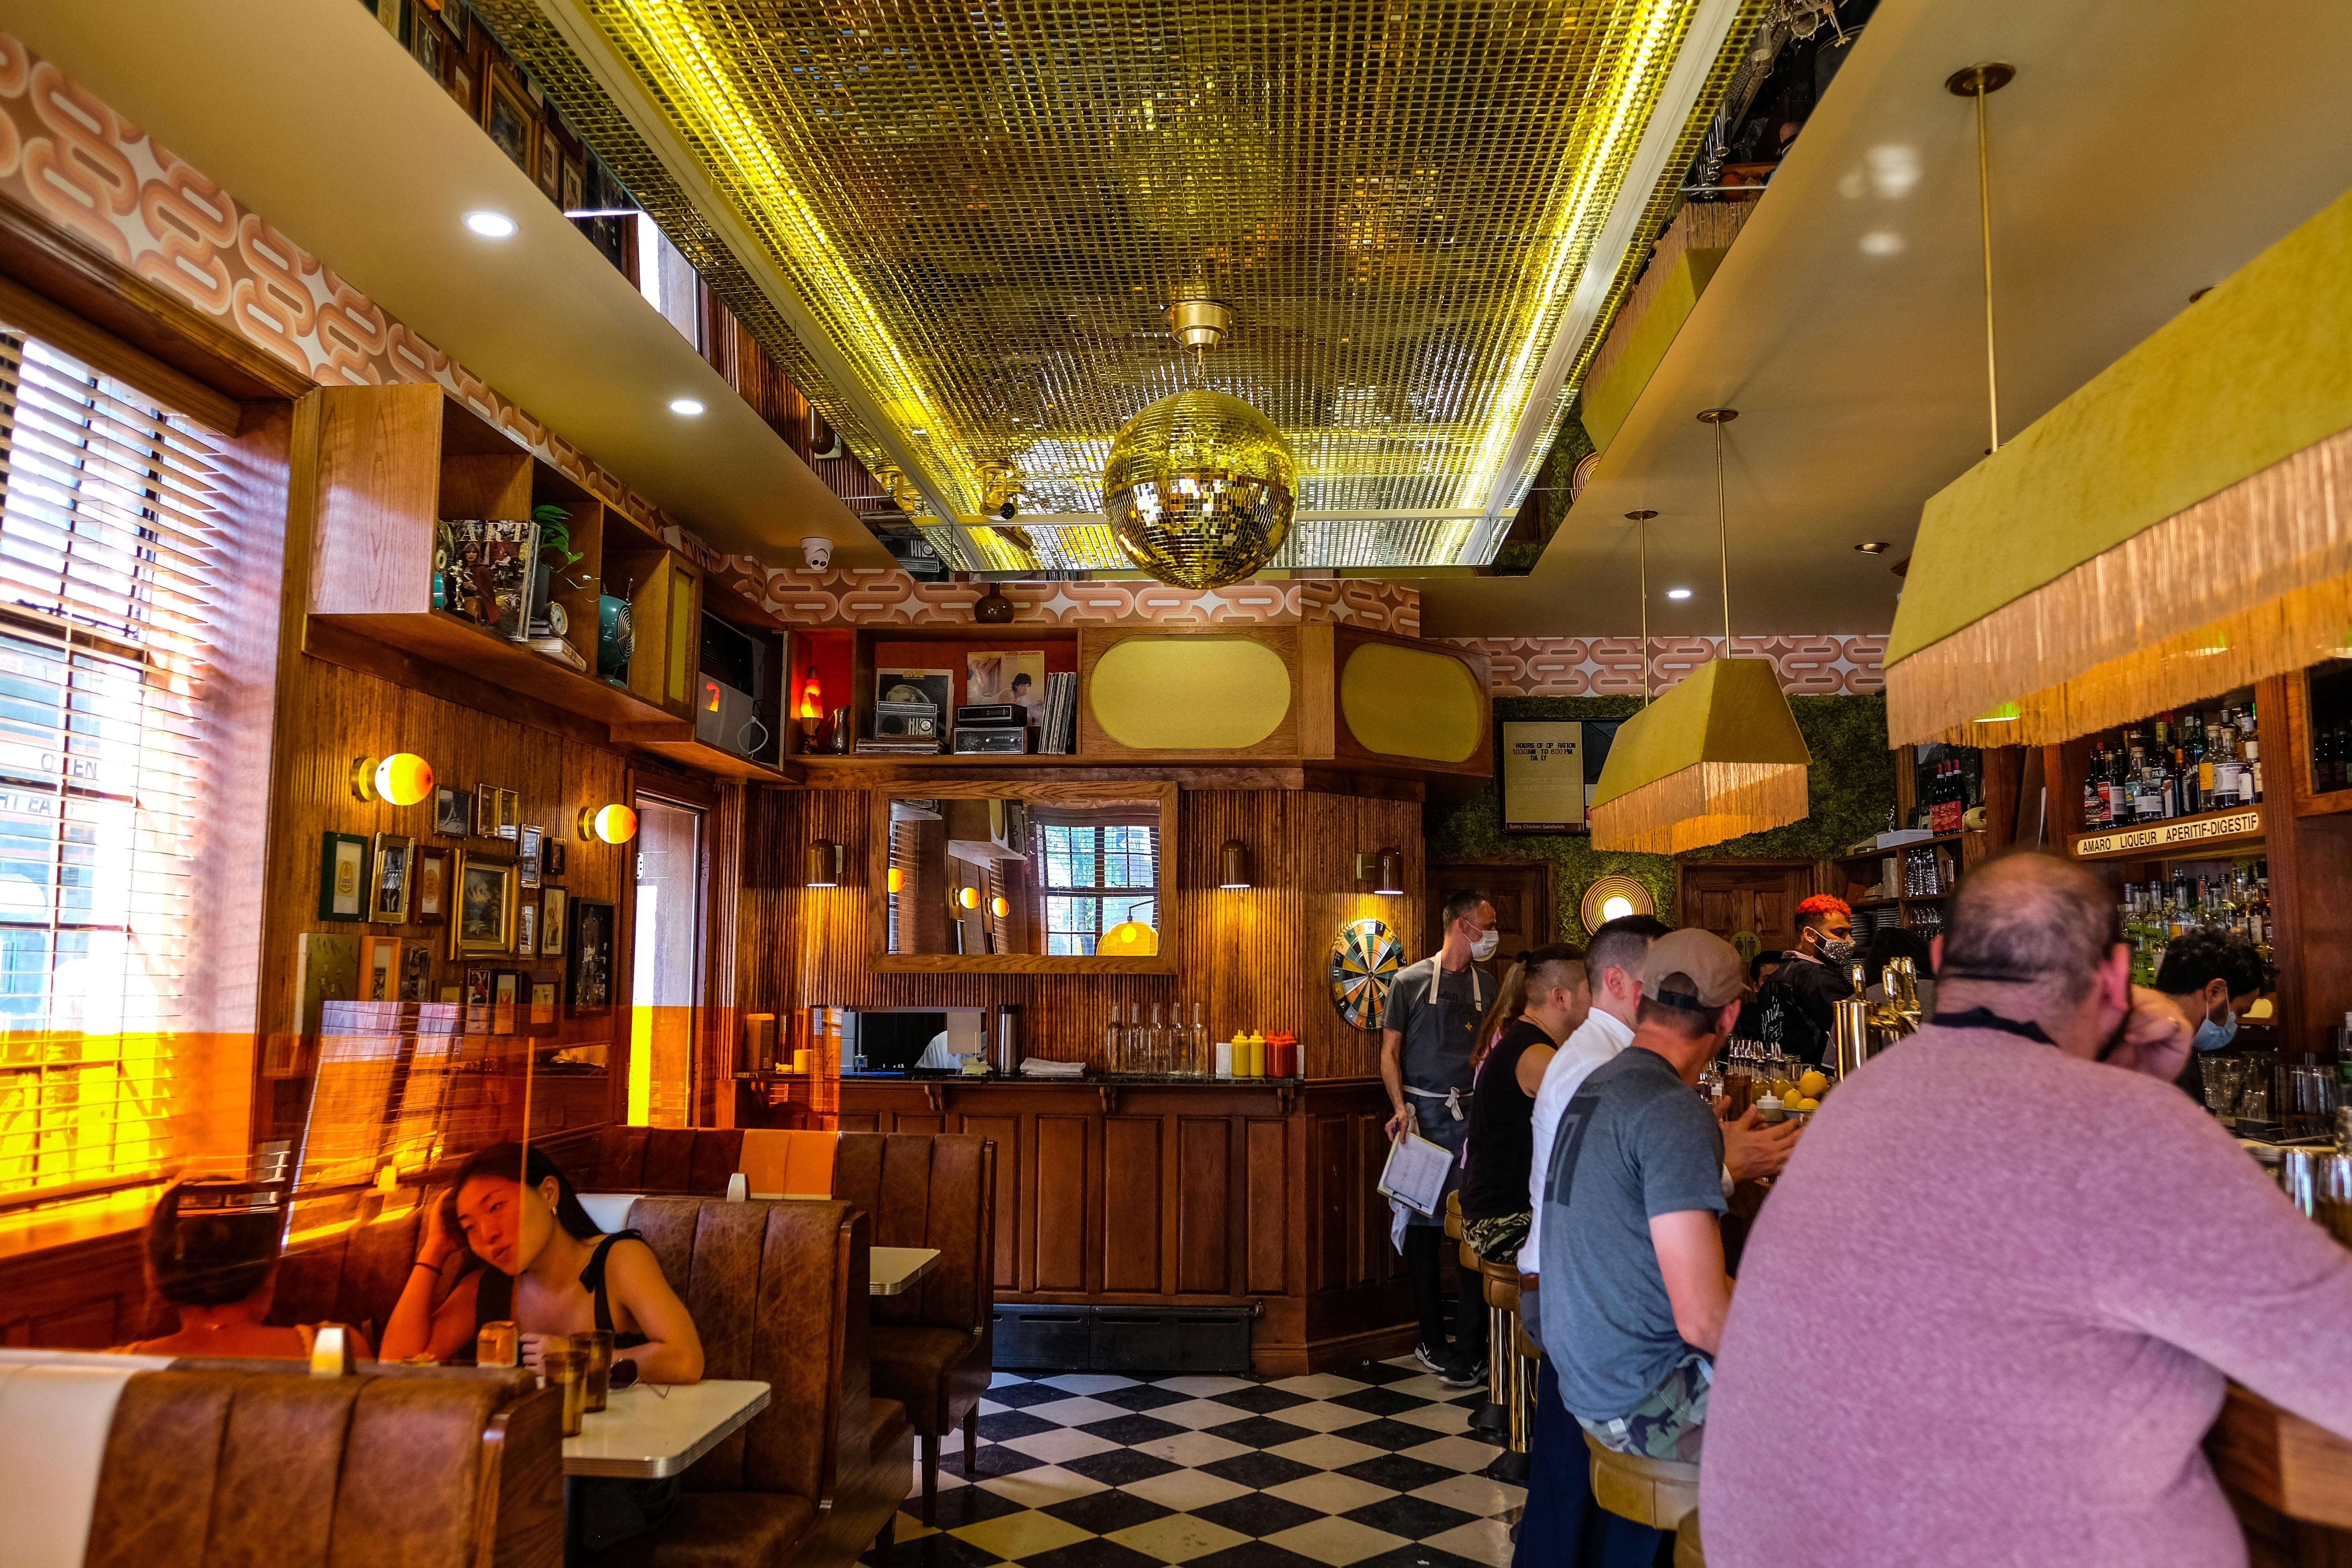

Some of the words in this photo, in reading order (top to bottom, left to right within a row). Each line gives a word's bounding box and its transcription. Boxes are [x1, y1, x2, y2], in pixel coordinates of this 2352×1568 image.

[41, 753, 97, 779] OEN
[2083, 838, 2111, 853] AMARO
[2120, 831, 2157, 848] LIQUEUR
[2166, 814, 2257, 842] APERITIF-DIGESTIF
